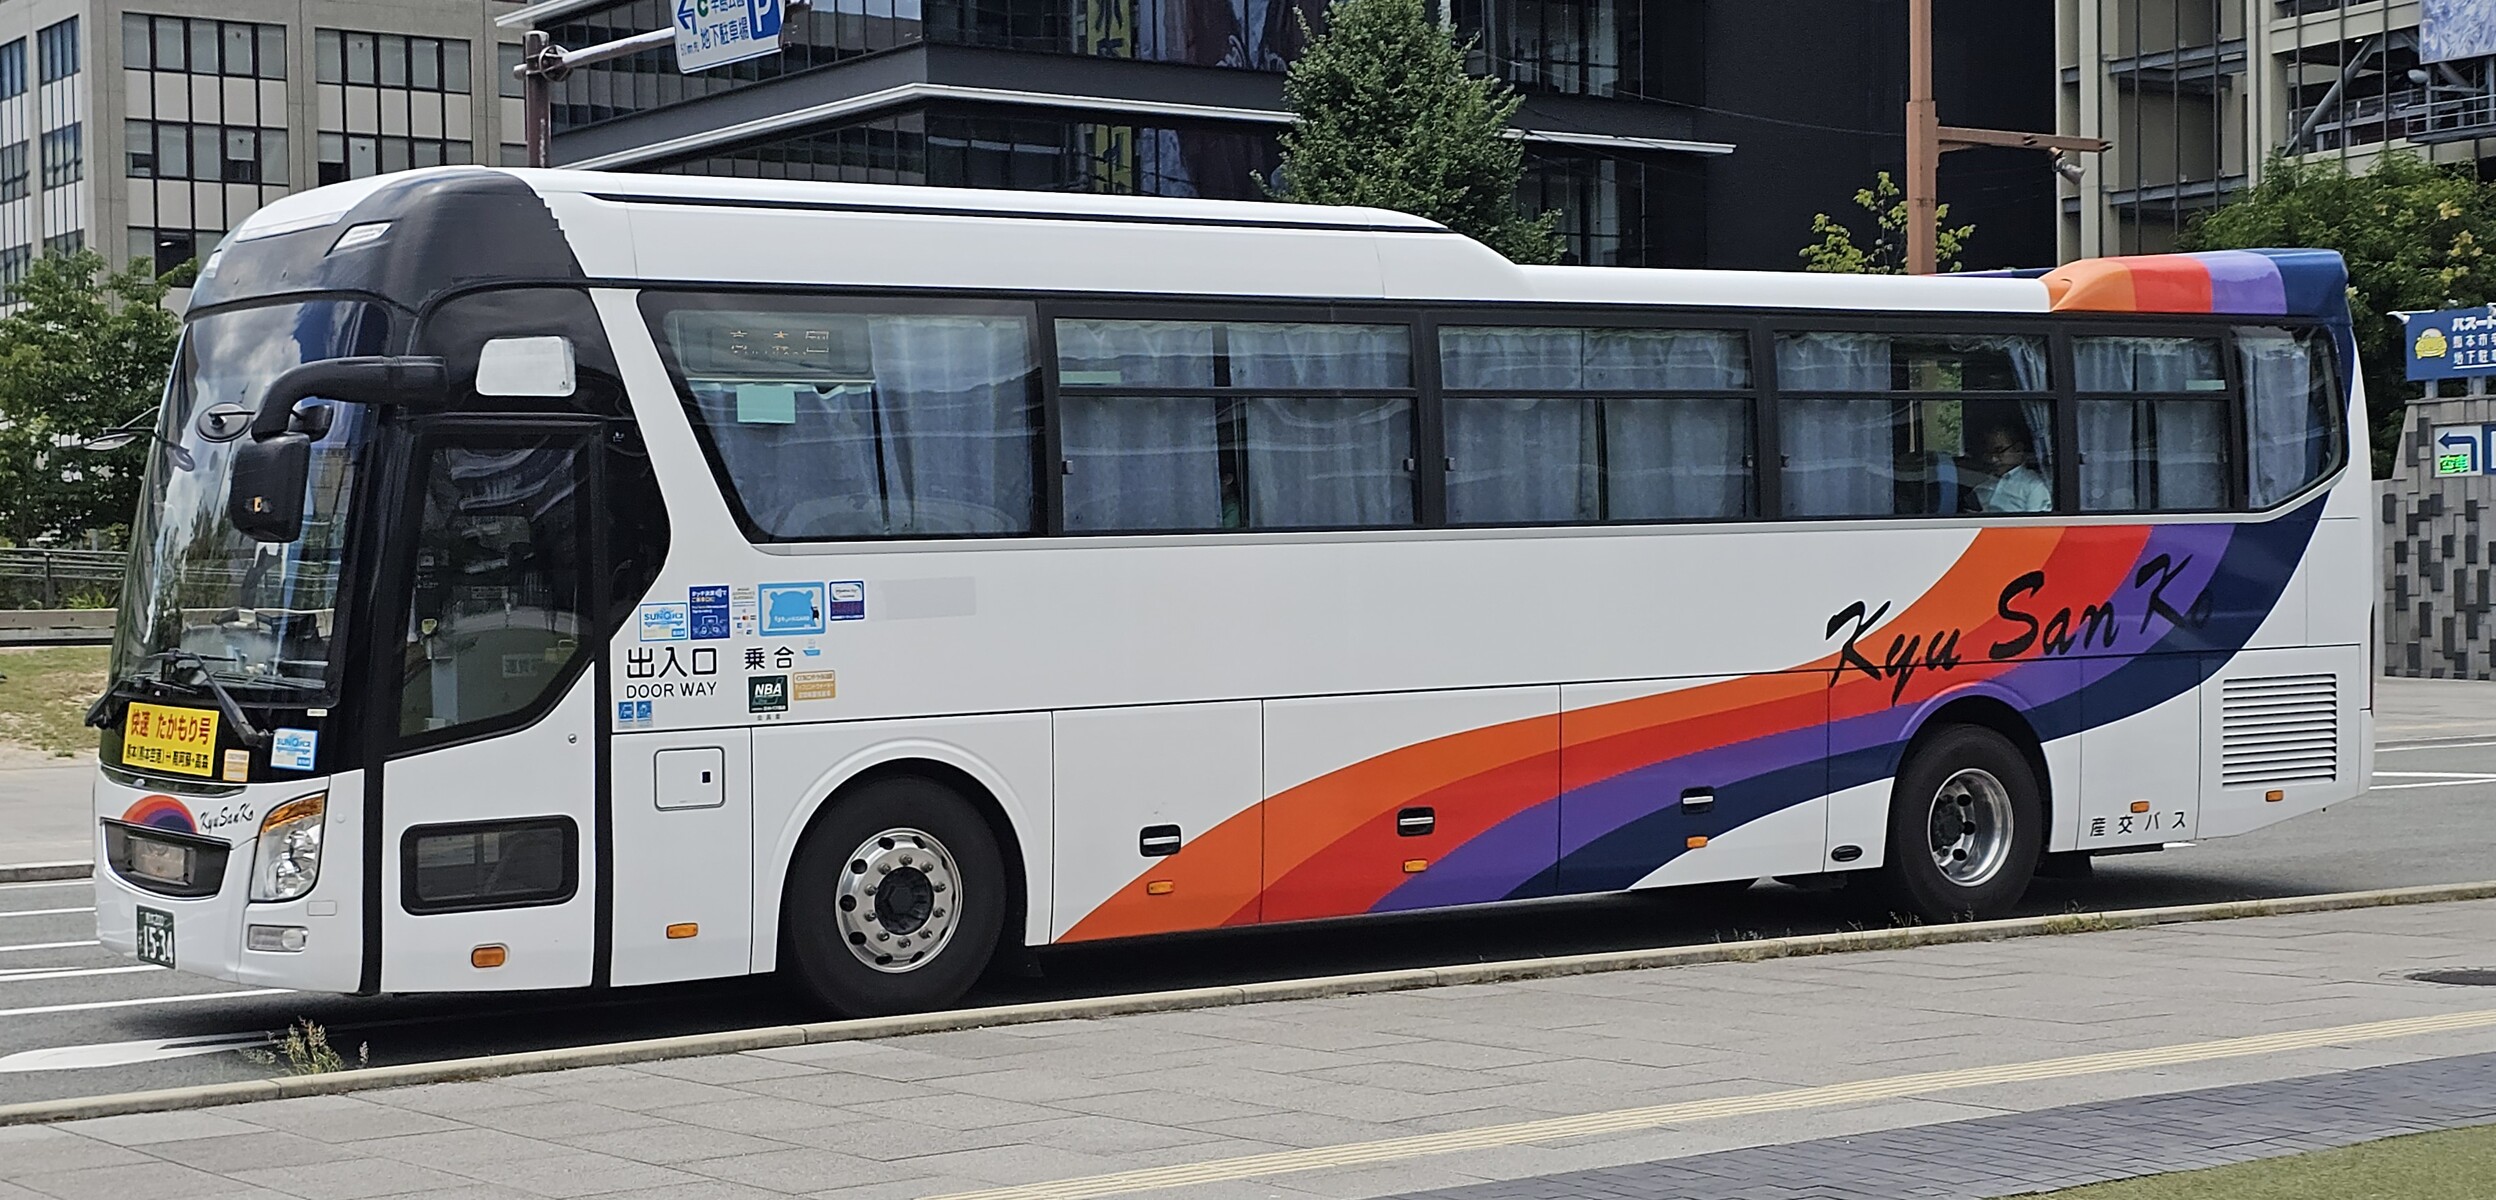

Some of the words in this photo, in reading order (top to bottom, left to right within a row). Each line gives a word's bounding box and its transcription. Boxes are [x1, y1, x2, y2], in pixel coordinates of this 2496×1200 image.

[700, 16, 750, 49] 地下駐車場
[1825, 600, 1962, 707] Kyu
[1989, 570, 2121, 660] San
[626, 647, 717, 678] 出入口
[744, 646, 794, 670] 乗合
[626, 683, 674, 699] DOOR
[680, 681, 717, 697] WAY
[755, 683, 782, 695] NBA
[156, 712, 211, 745] たかもり号
[2090, 811, 2186, 837] 産交バス
